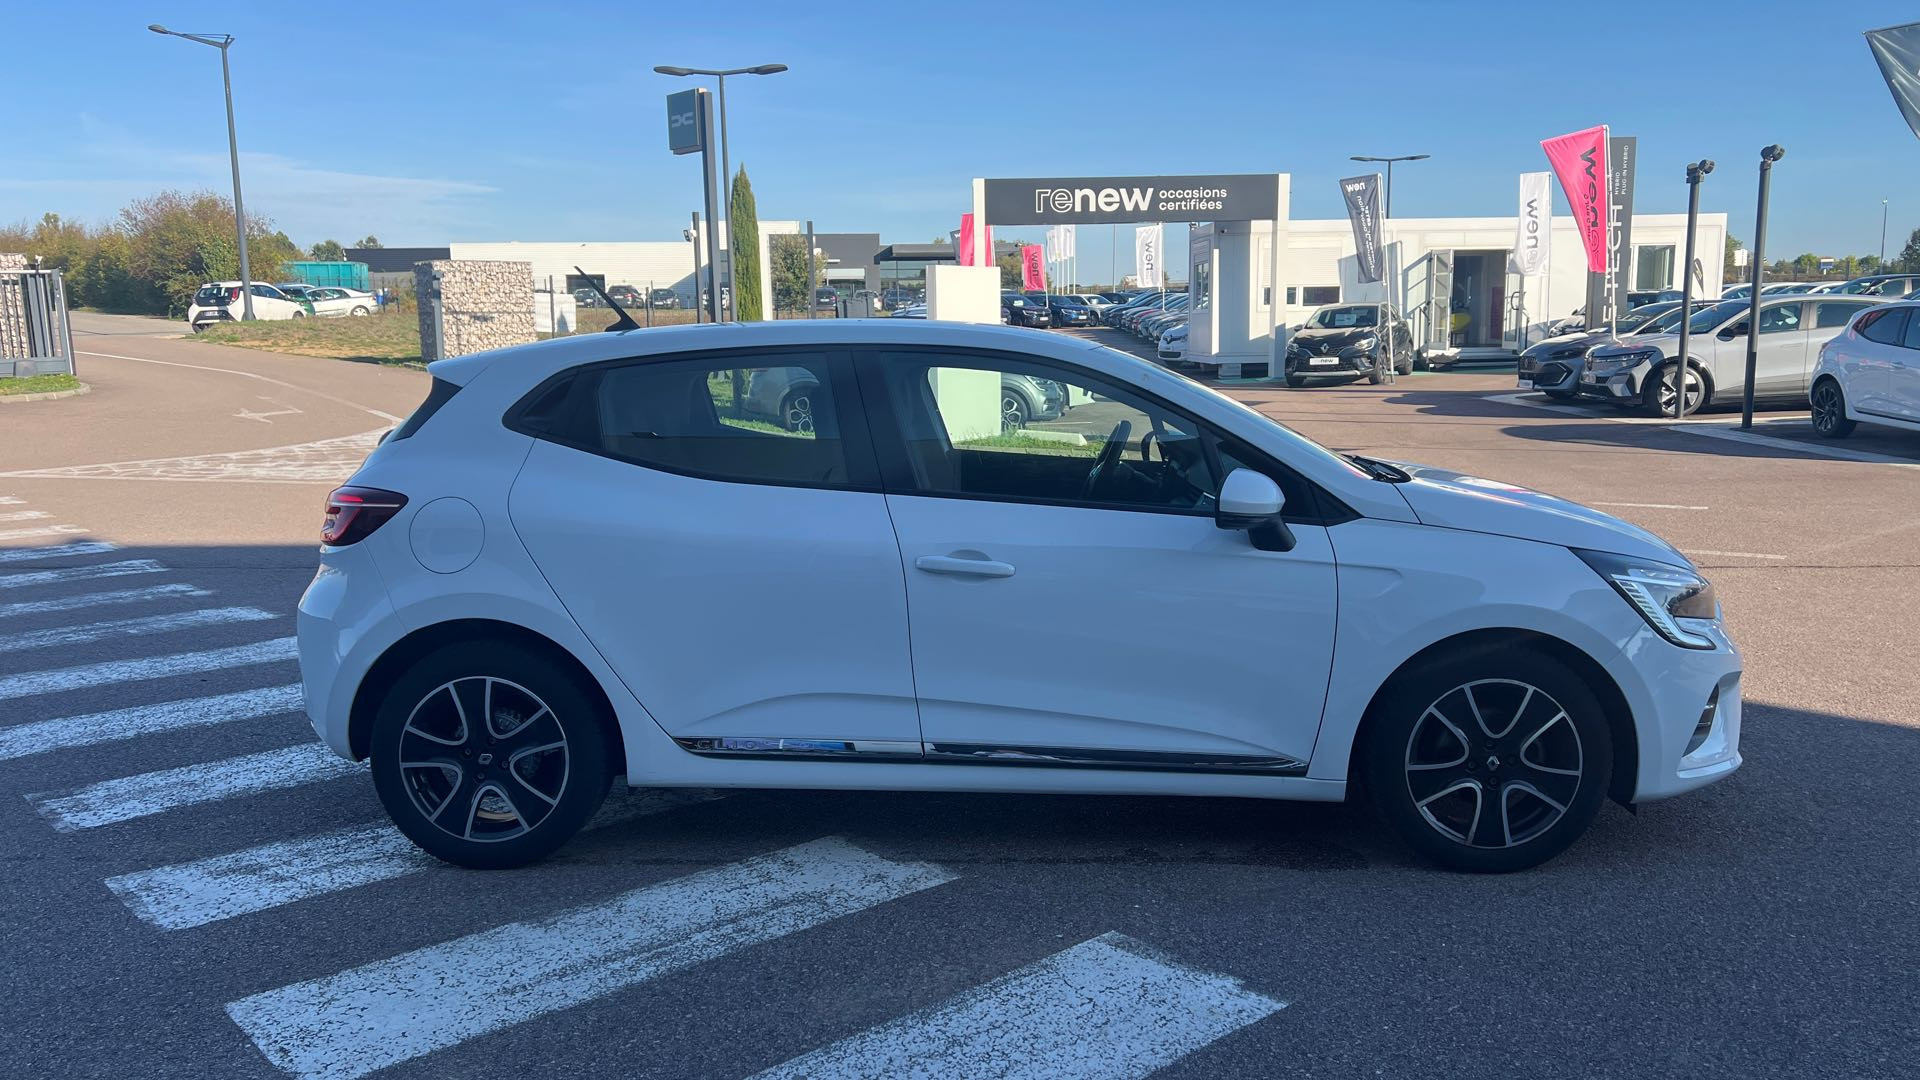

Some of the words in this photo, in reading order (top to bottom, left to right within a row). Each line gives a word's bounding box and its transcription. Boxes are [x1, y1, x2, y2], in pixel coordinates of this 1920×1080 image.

[1158, 187, 1227, 199] occasions
[1035, 187, 1154, 213] renew
[1158, 199, 1223, 211] certifiées
